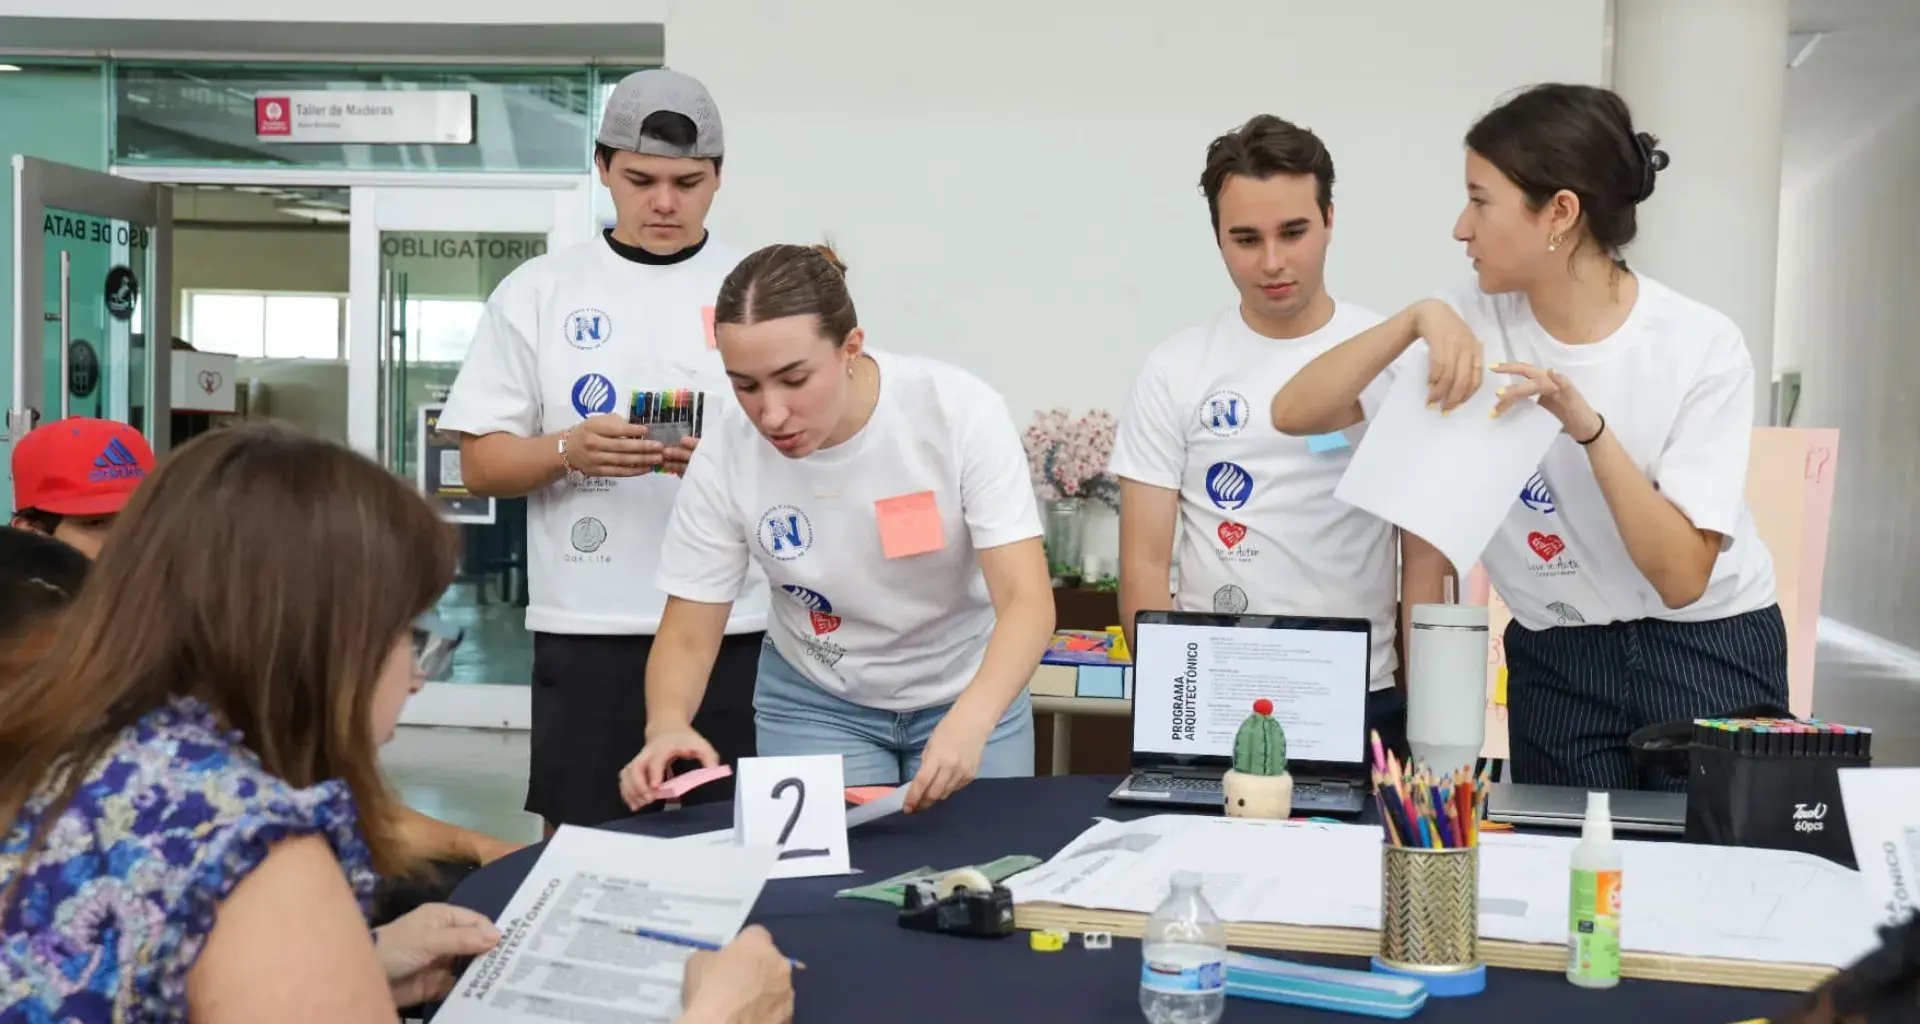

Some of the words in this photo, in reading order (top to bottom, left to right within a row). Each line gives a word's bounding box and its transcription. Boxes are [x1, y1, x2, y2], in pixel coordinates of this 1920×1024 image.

[296, 104, 326, 116] Taller
[329, 104, 343, 116] de
[346, 105, 393, 116] Maderas
[382, 237, 548, 260] OBLIGATORIO
[1171, 676, 1184, 741] PROGRAMA
[1184, 642, 1198, 742] ARQUITECTÓNICO
[771, 777, 830, 861] 2
[1794, 820, 1824, 834] 60pcs
